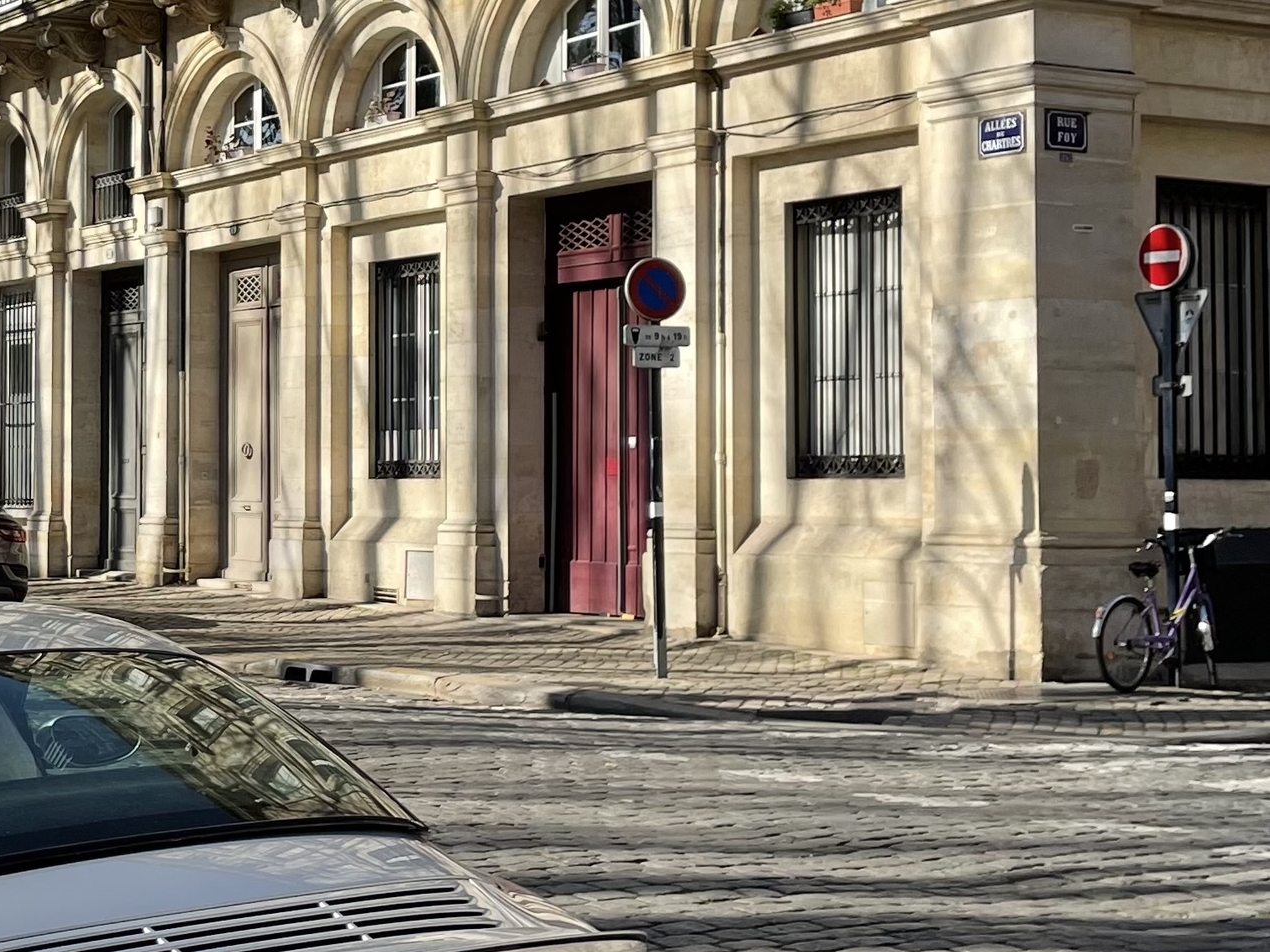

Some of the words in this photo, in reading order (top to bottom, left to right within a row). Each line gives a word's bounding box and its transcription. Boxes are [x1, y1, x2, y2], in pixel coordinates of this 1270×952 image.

[984, 117, 1017, 133] ALLÉES
[1056, 116, 1078, 129] RUE
[980, 135, 1022, 153] CHARTRES
[1056, 131, 1078, 144] FOY
[639, 353, 663, 362] ZONE
[669, 353, 675, 362] 2
